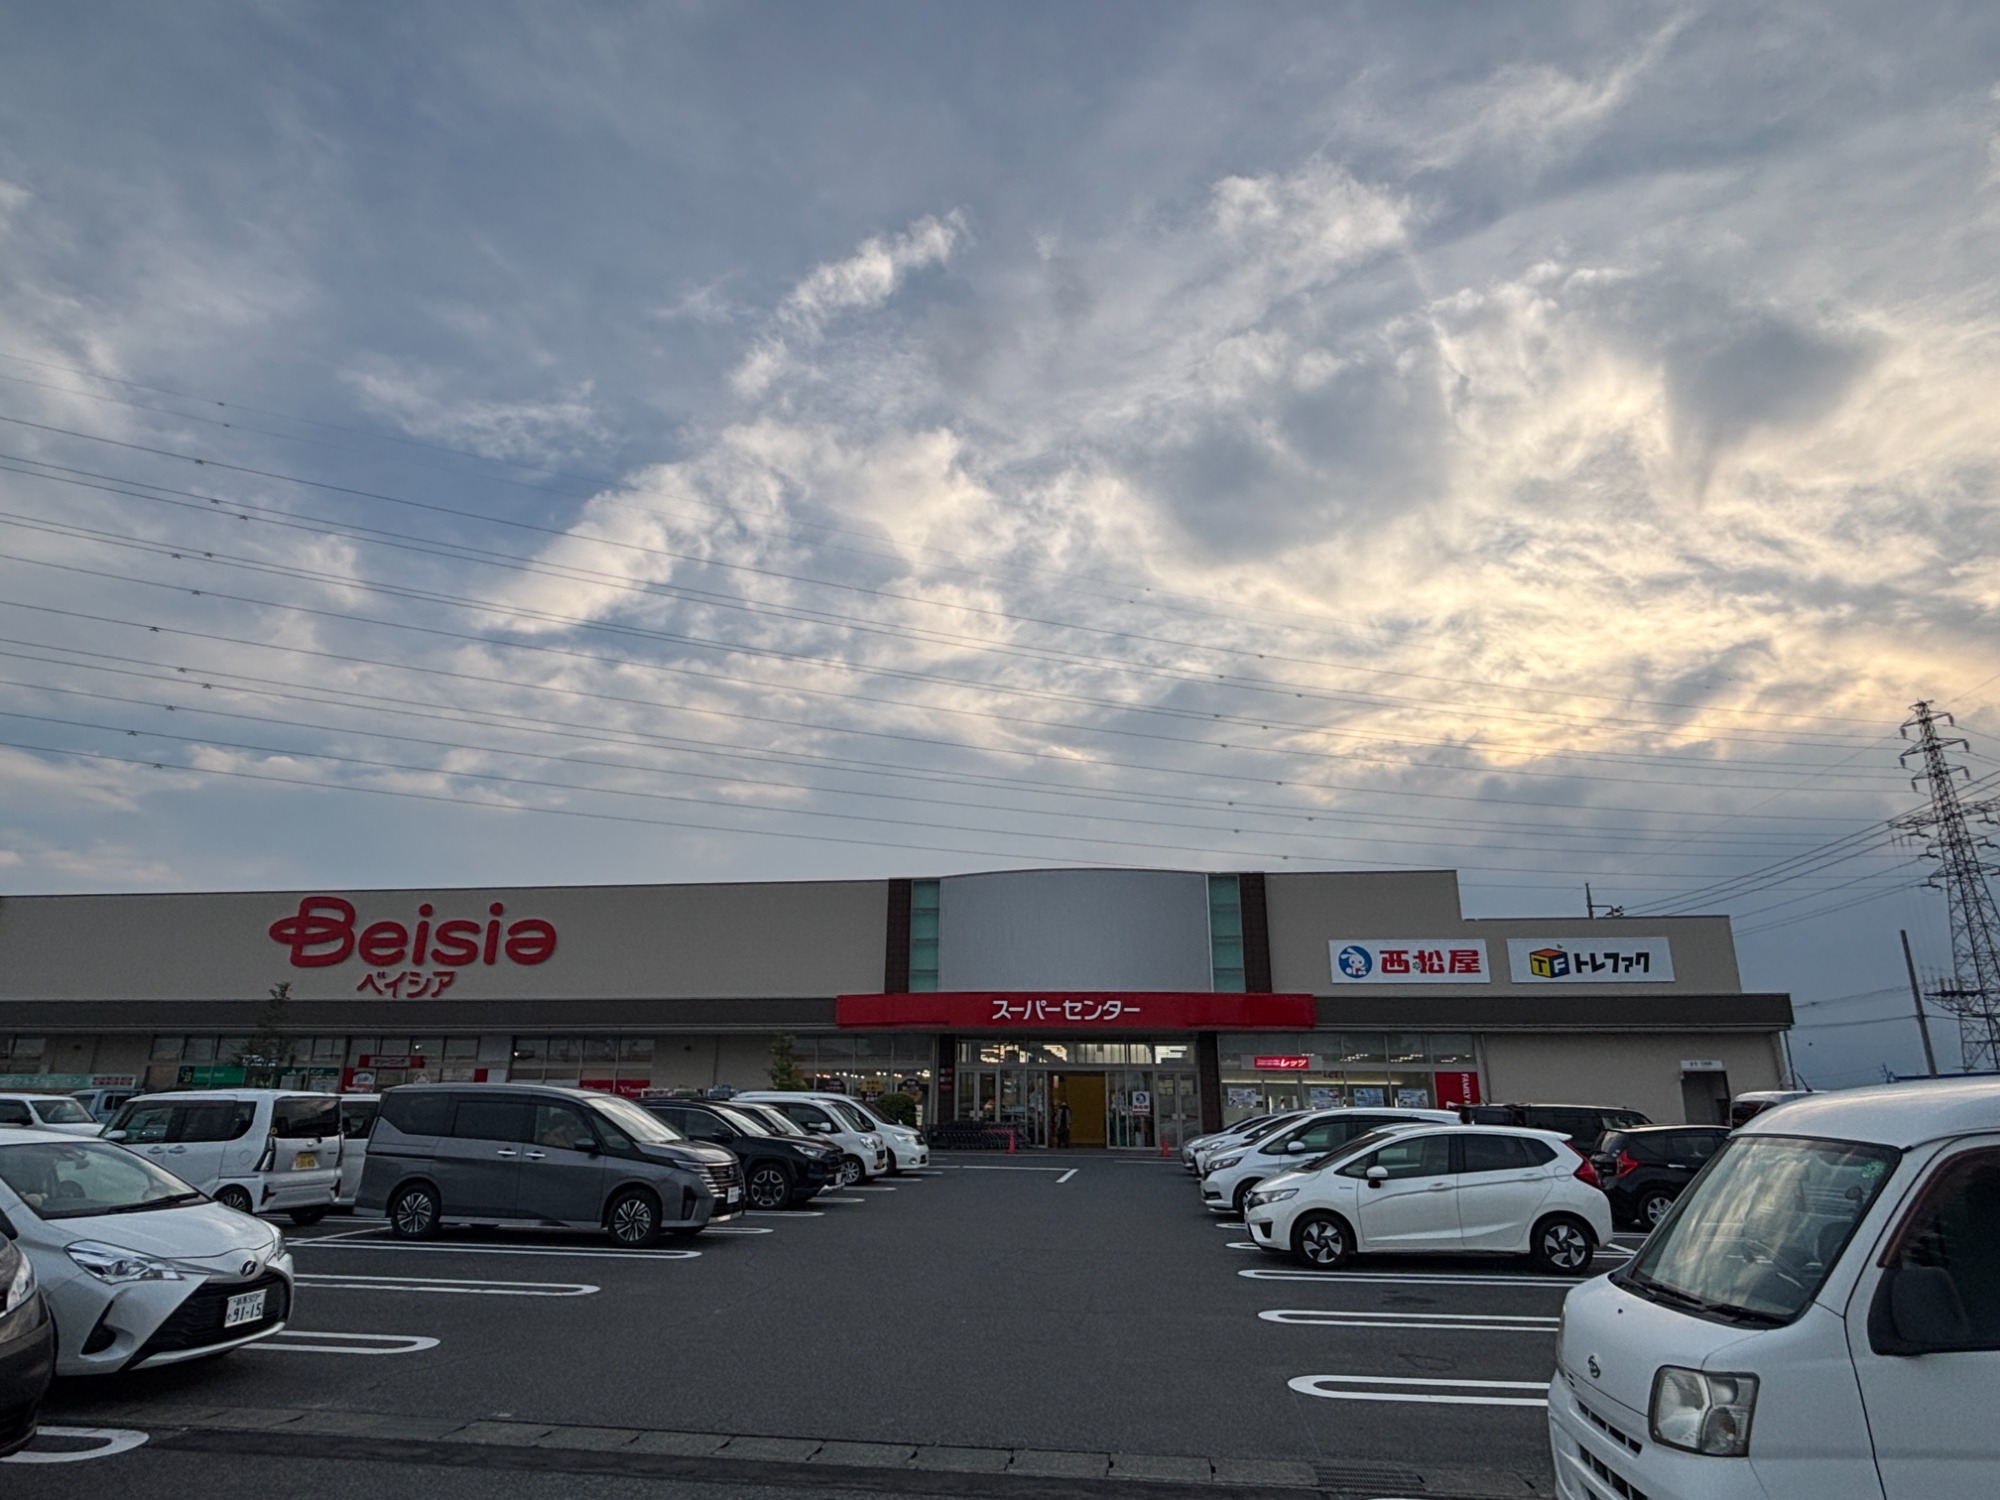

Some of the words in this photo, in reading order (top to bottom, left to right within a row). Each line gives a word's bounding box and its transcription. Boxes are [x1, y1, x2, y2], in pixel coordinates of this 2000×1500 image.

[269, 896, 557, 967] Beisia
[1379, 949, 1481, 974] 西松屋
[1574, 952, 1650, 973] トレファク
[357, 971, 456, 998] ベイシア
[992, 1000, 1140, 1020] スーパーセンター
[1280, 1058, 1307, 1067] レッツ
[232, 1302, 262, 1322] 91-15
